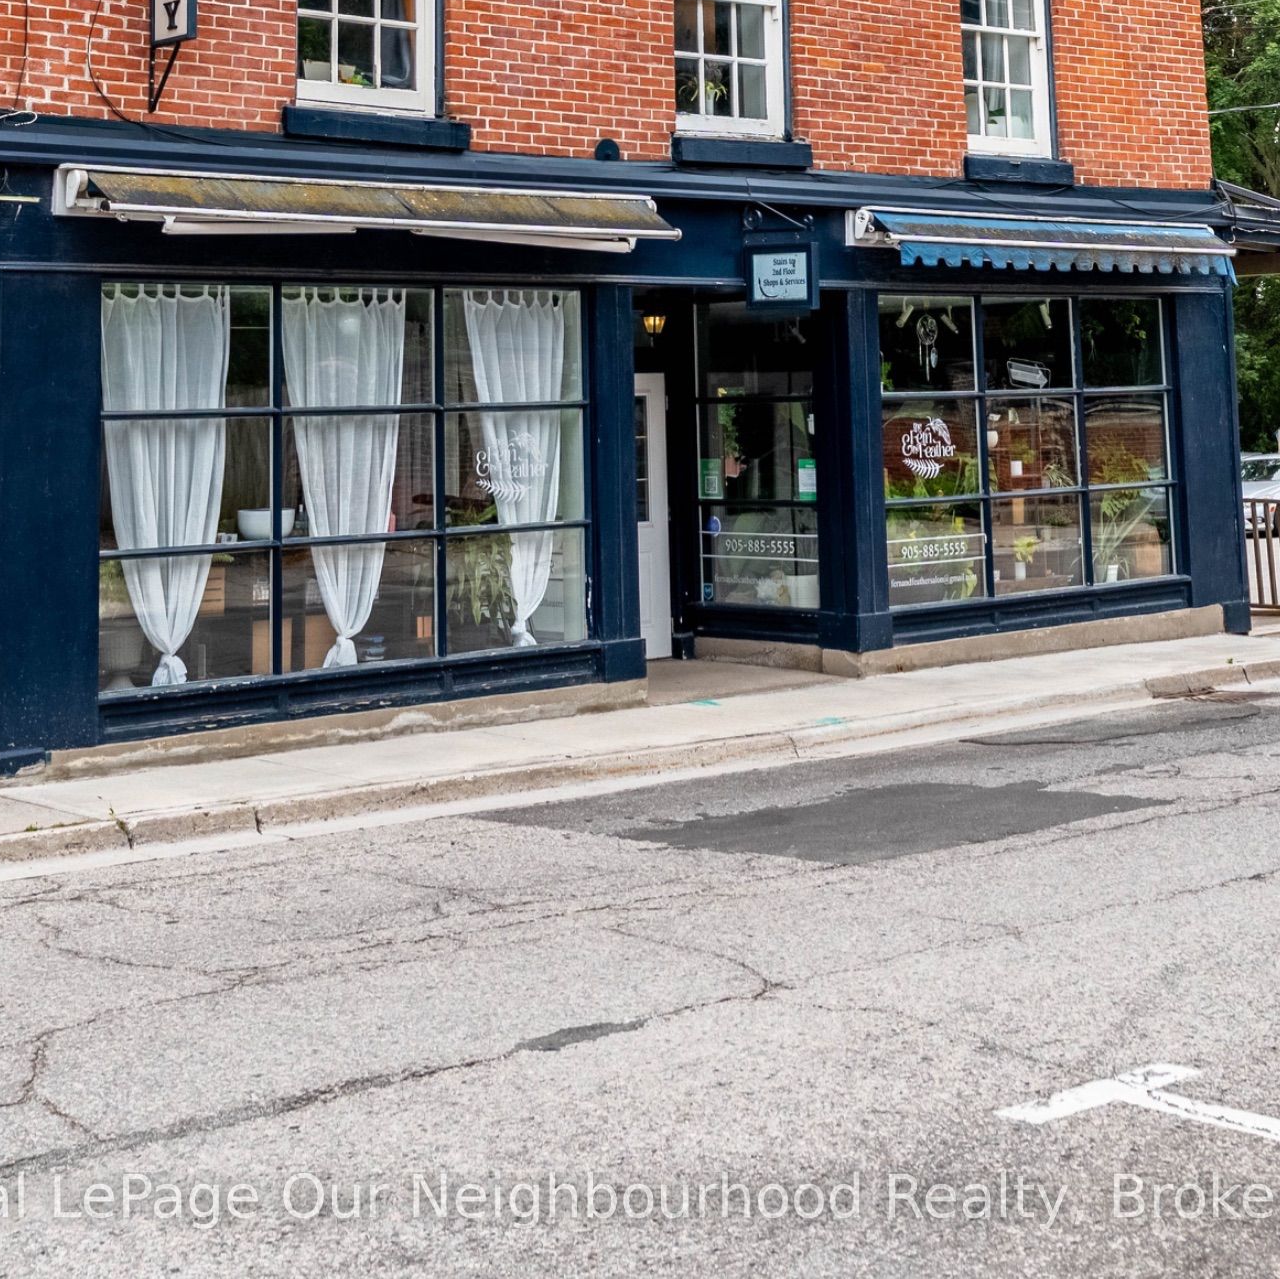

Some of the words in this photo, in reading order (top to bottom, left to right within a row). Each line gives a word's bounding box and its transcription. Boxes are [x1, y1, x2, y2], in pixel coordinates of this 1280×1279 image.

[763, 279, 778, 287] Shops
[919, 440, 956, 458] Feather
[725, 538, 795, 554] 905-885-5555
[901, 542, 966, 559] 905-885-5555
